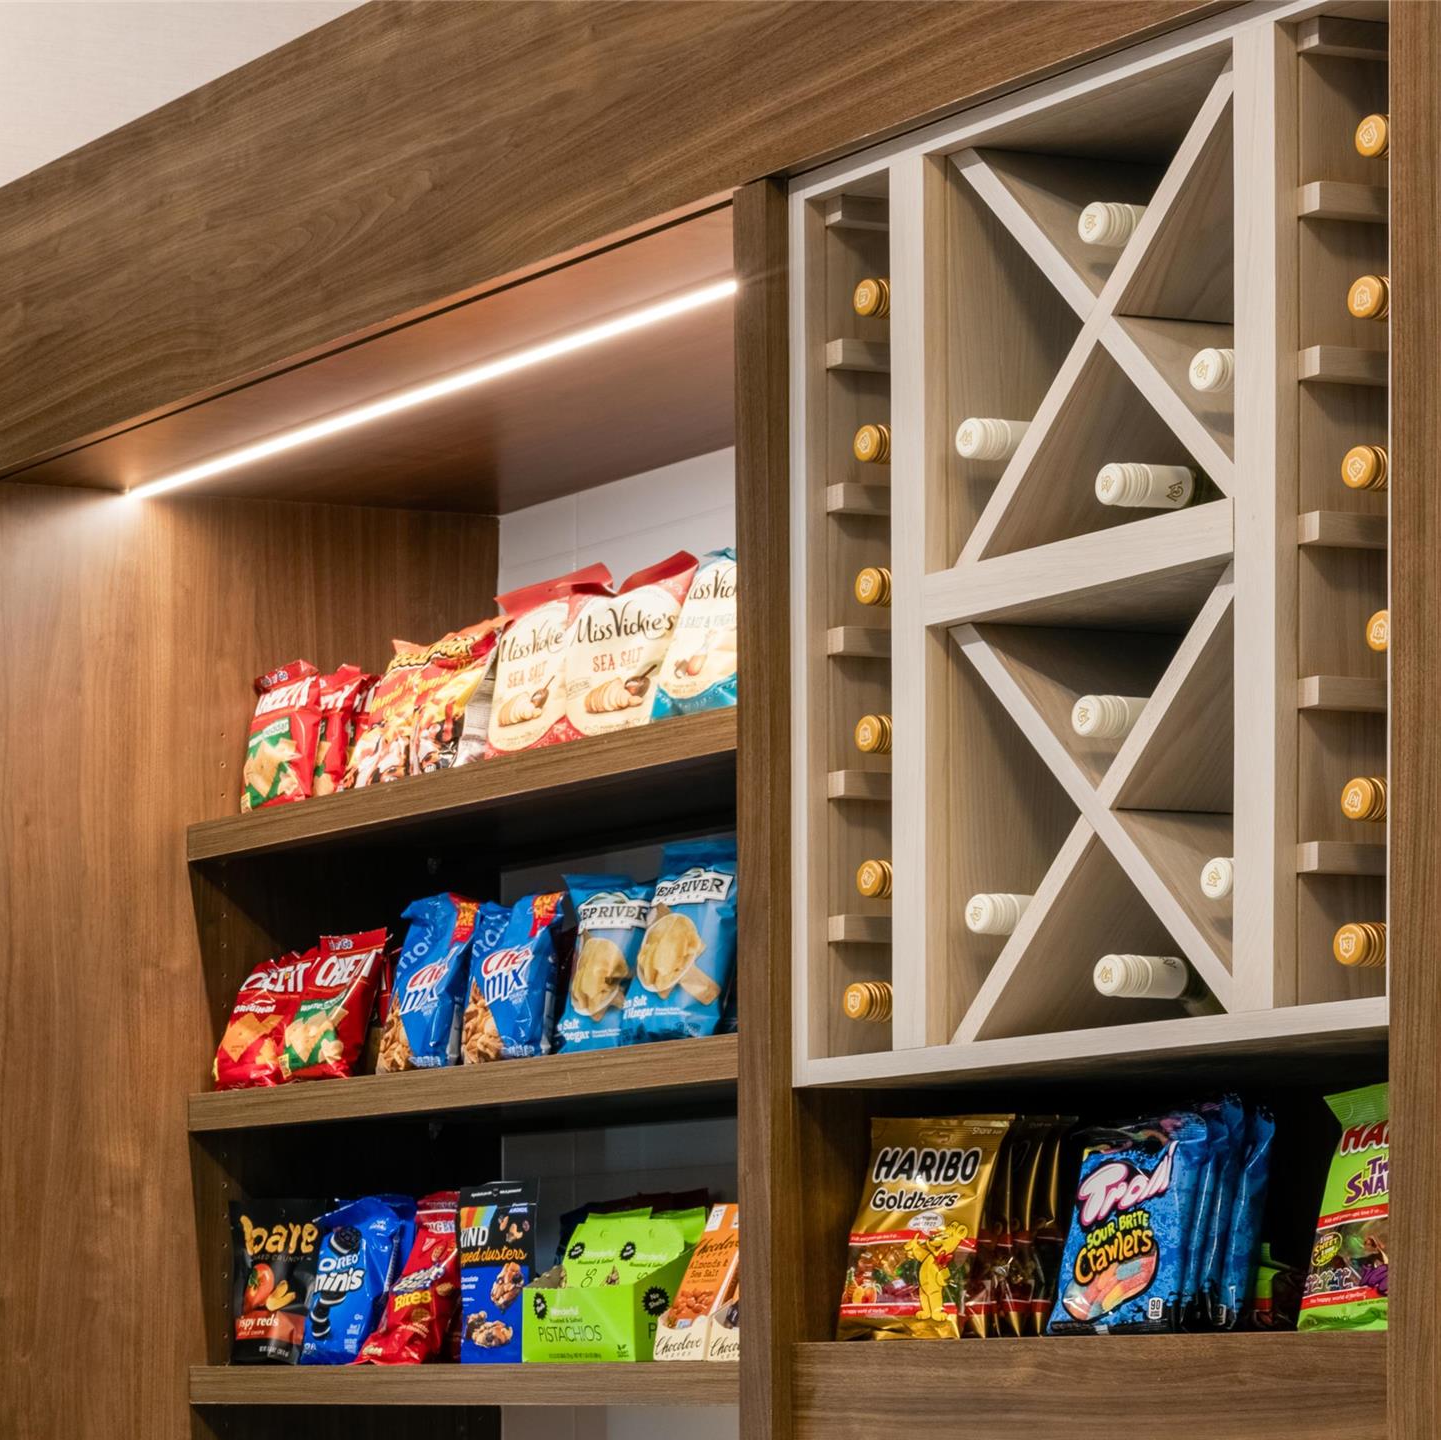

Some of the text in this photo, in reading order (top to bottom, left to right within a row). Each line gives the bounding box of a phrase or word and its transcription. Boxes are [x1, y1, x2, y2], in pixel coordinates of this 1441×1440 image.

[570, 601, 676, 646] Miss Vickie's
[592, 647, 644, 673] SEA SALT
[680, 878, 725, 896] RIVER
[873, 1148, 982, 1184] HARIBO
[871, 1189, 958, 1211] Goldbears
[240, 1215, 318, 1255] bare
[1085, 1222, 1116, 1248] SOUR
[319, 1253, 359, 1272] OREO
[1074, 1229, 1153, 1285] Crawlers
[394, 1290, 431, 1312] Bites
[1150, 1300, 1160, 1311] 90
[538, 1325, 603, 1343] PISTACHIOS
